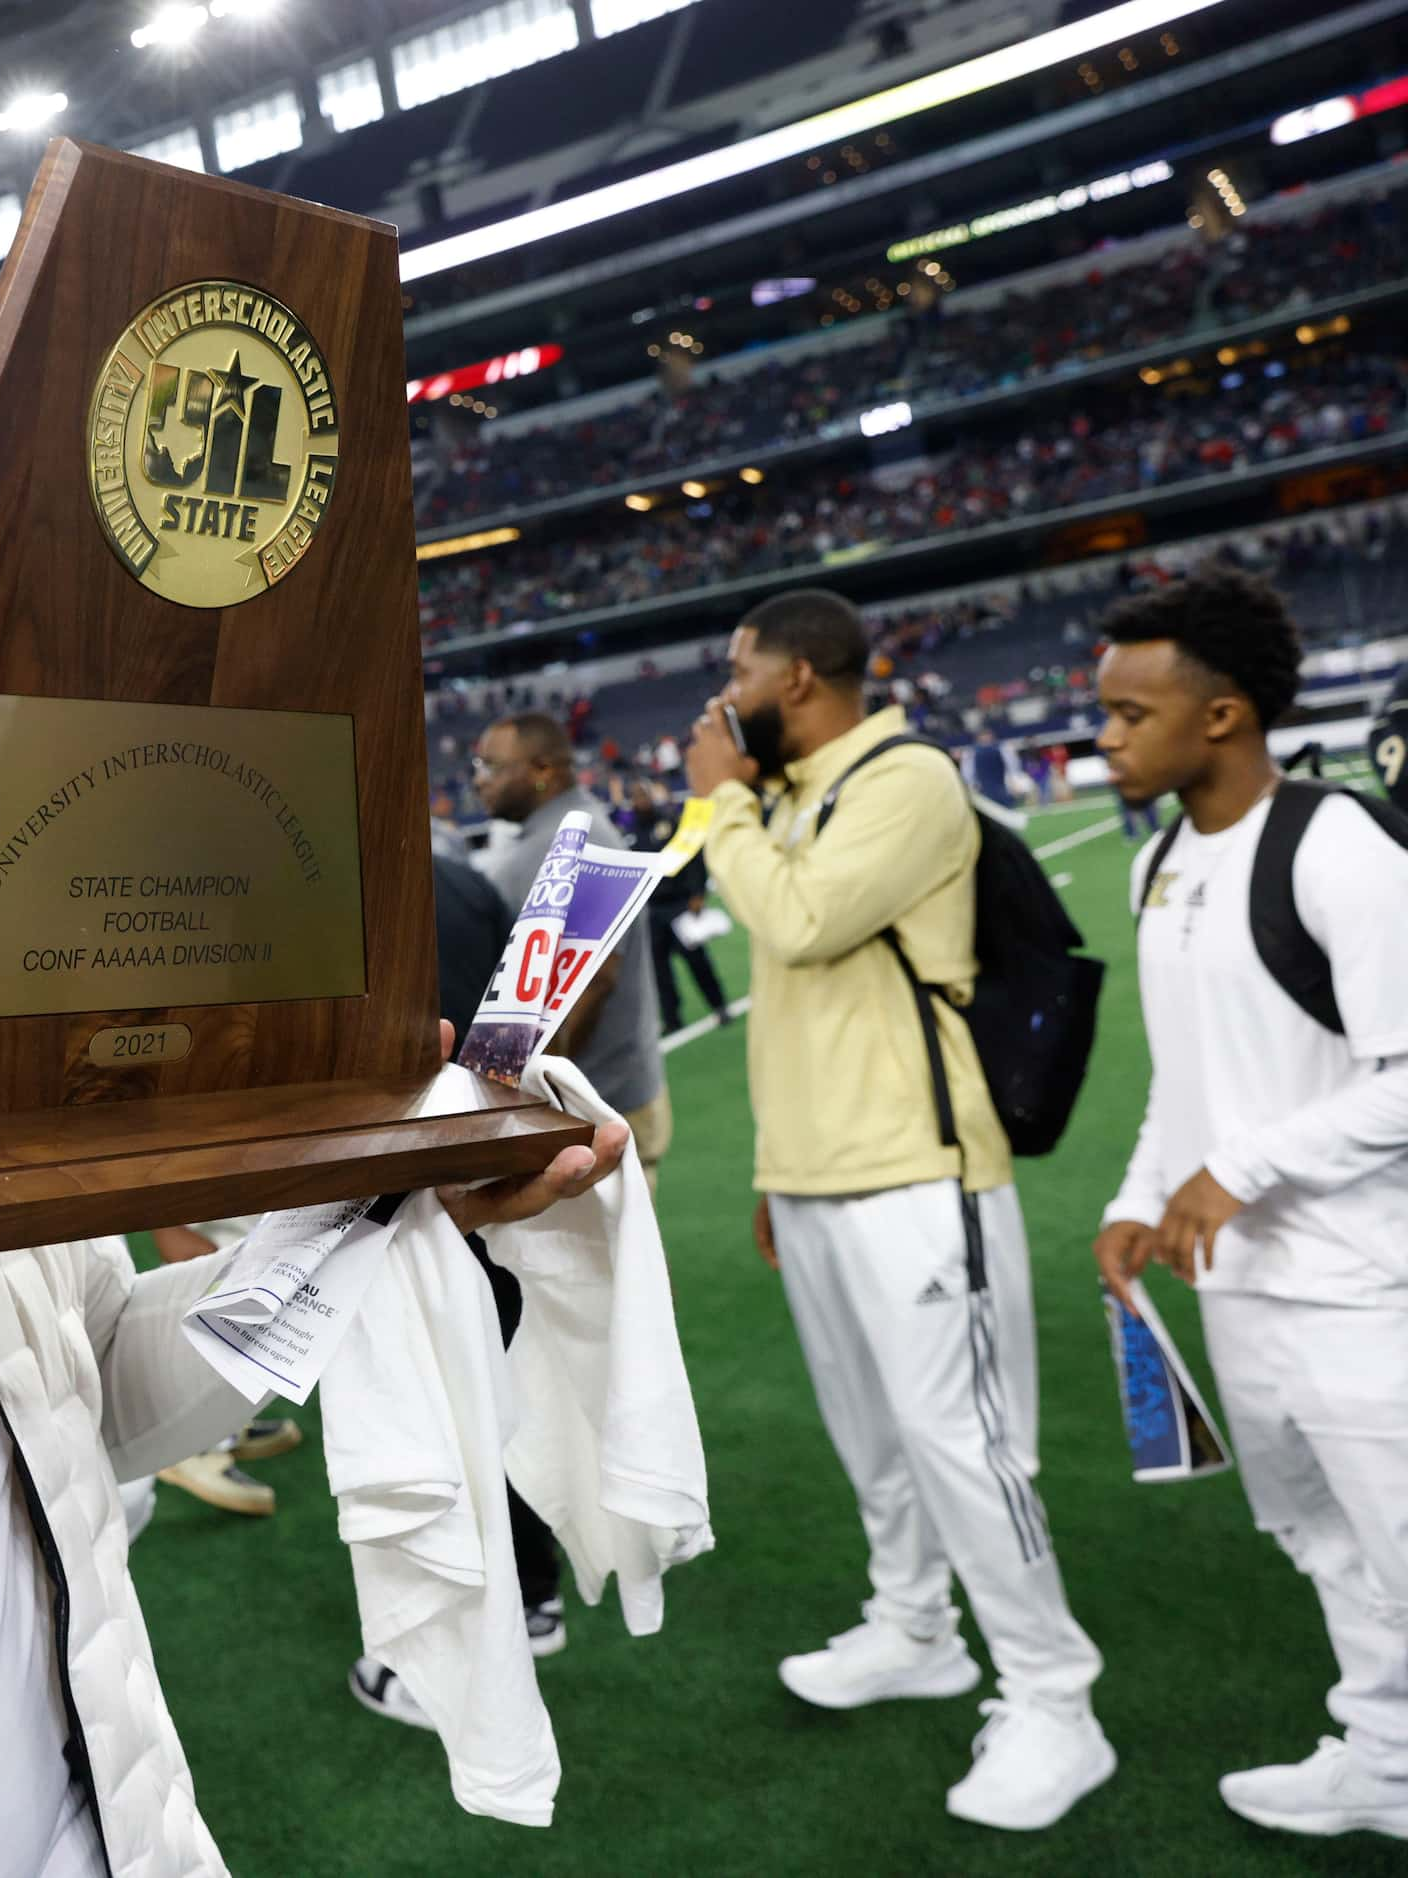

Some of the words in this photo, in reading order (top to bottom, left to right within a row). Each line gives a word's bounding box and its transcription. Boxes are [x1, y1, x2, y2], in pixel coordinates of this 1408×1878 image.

[95, 352, 155, 568] UNIVERSITY
[143, 288, 336, 429] INTERSCHOLASTIC
[264, 461, 334, 578] LEAGUE
[143, 350, 292, 503] UIL
[159, 494, 259, 541] STATE
[102, 741, 281, 809] INTERSCHOLASTIC
[274, 803, 322, 885] LEAGUE
[602, 866, 644, 879] EDITION
[68, 875, 135, 899] STATE
[138, 874, 252, 898] CHAMPION
[522, 880, 575, 908] OO
[102, 910, 211, 934] FOOTBALL
[22, 947, 88, 973] CONF
[90, 945, 168, 970] AAAAA
[171, 942, 260, 967] DIVISION
[261, 942, 274, 963] II
[112, 1031, 167, 1058] 2021
[292, 1291, 335, 1318] RANCE
[239, 1329, 271, 1353] Bureau
[280, 1319, 315, 1342] brought
